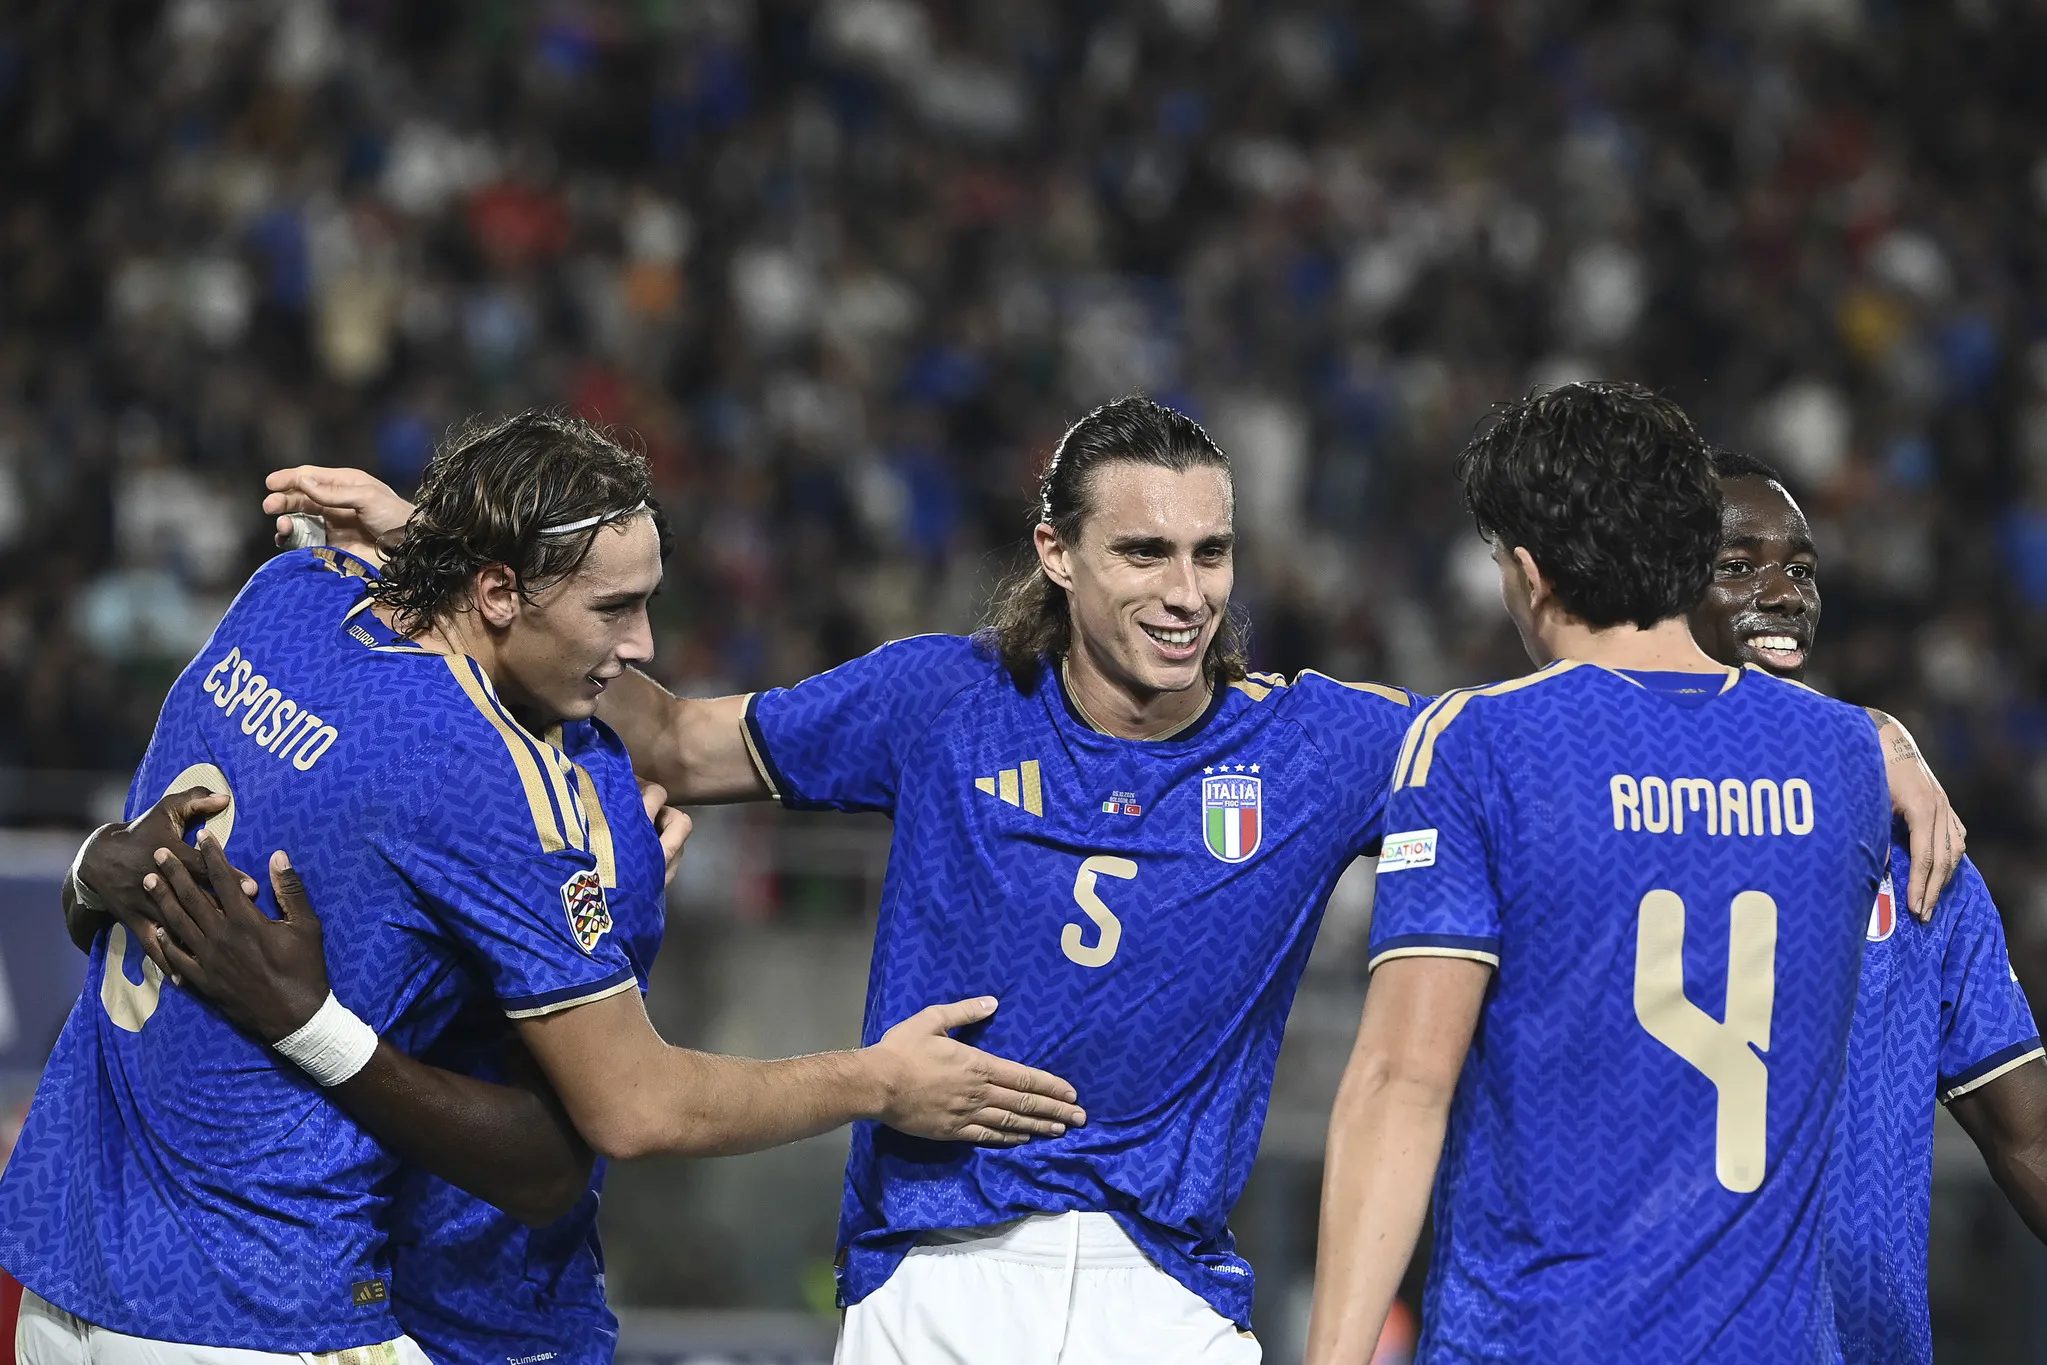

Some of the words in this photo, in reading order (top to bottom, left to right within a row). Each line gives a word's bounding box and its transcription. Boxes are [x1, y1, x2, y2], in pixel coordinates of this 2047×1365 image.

[203, 647, 338, 771] ESPOSITO
[1206, 783, 1256, 800] ITALIA
[1609, 774, 1814, 836] ROMANO
[1061, 855, 1138, 968] 5
[1633, 889, 1778, 1193] 4
